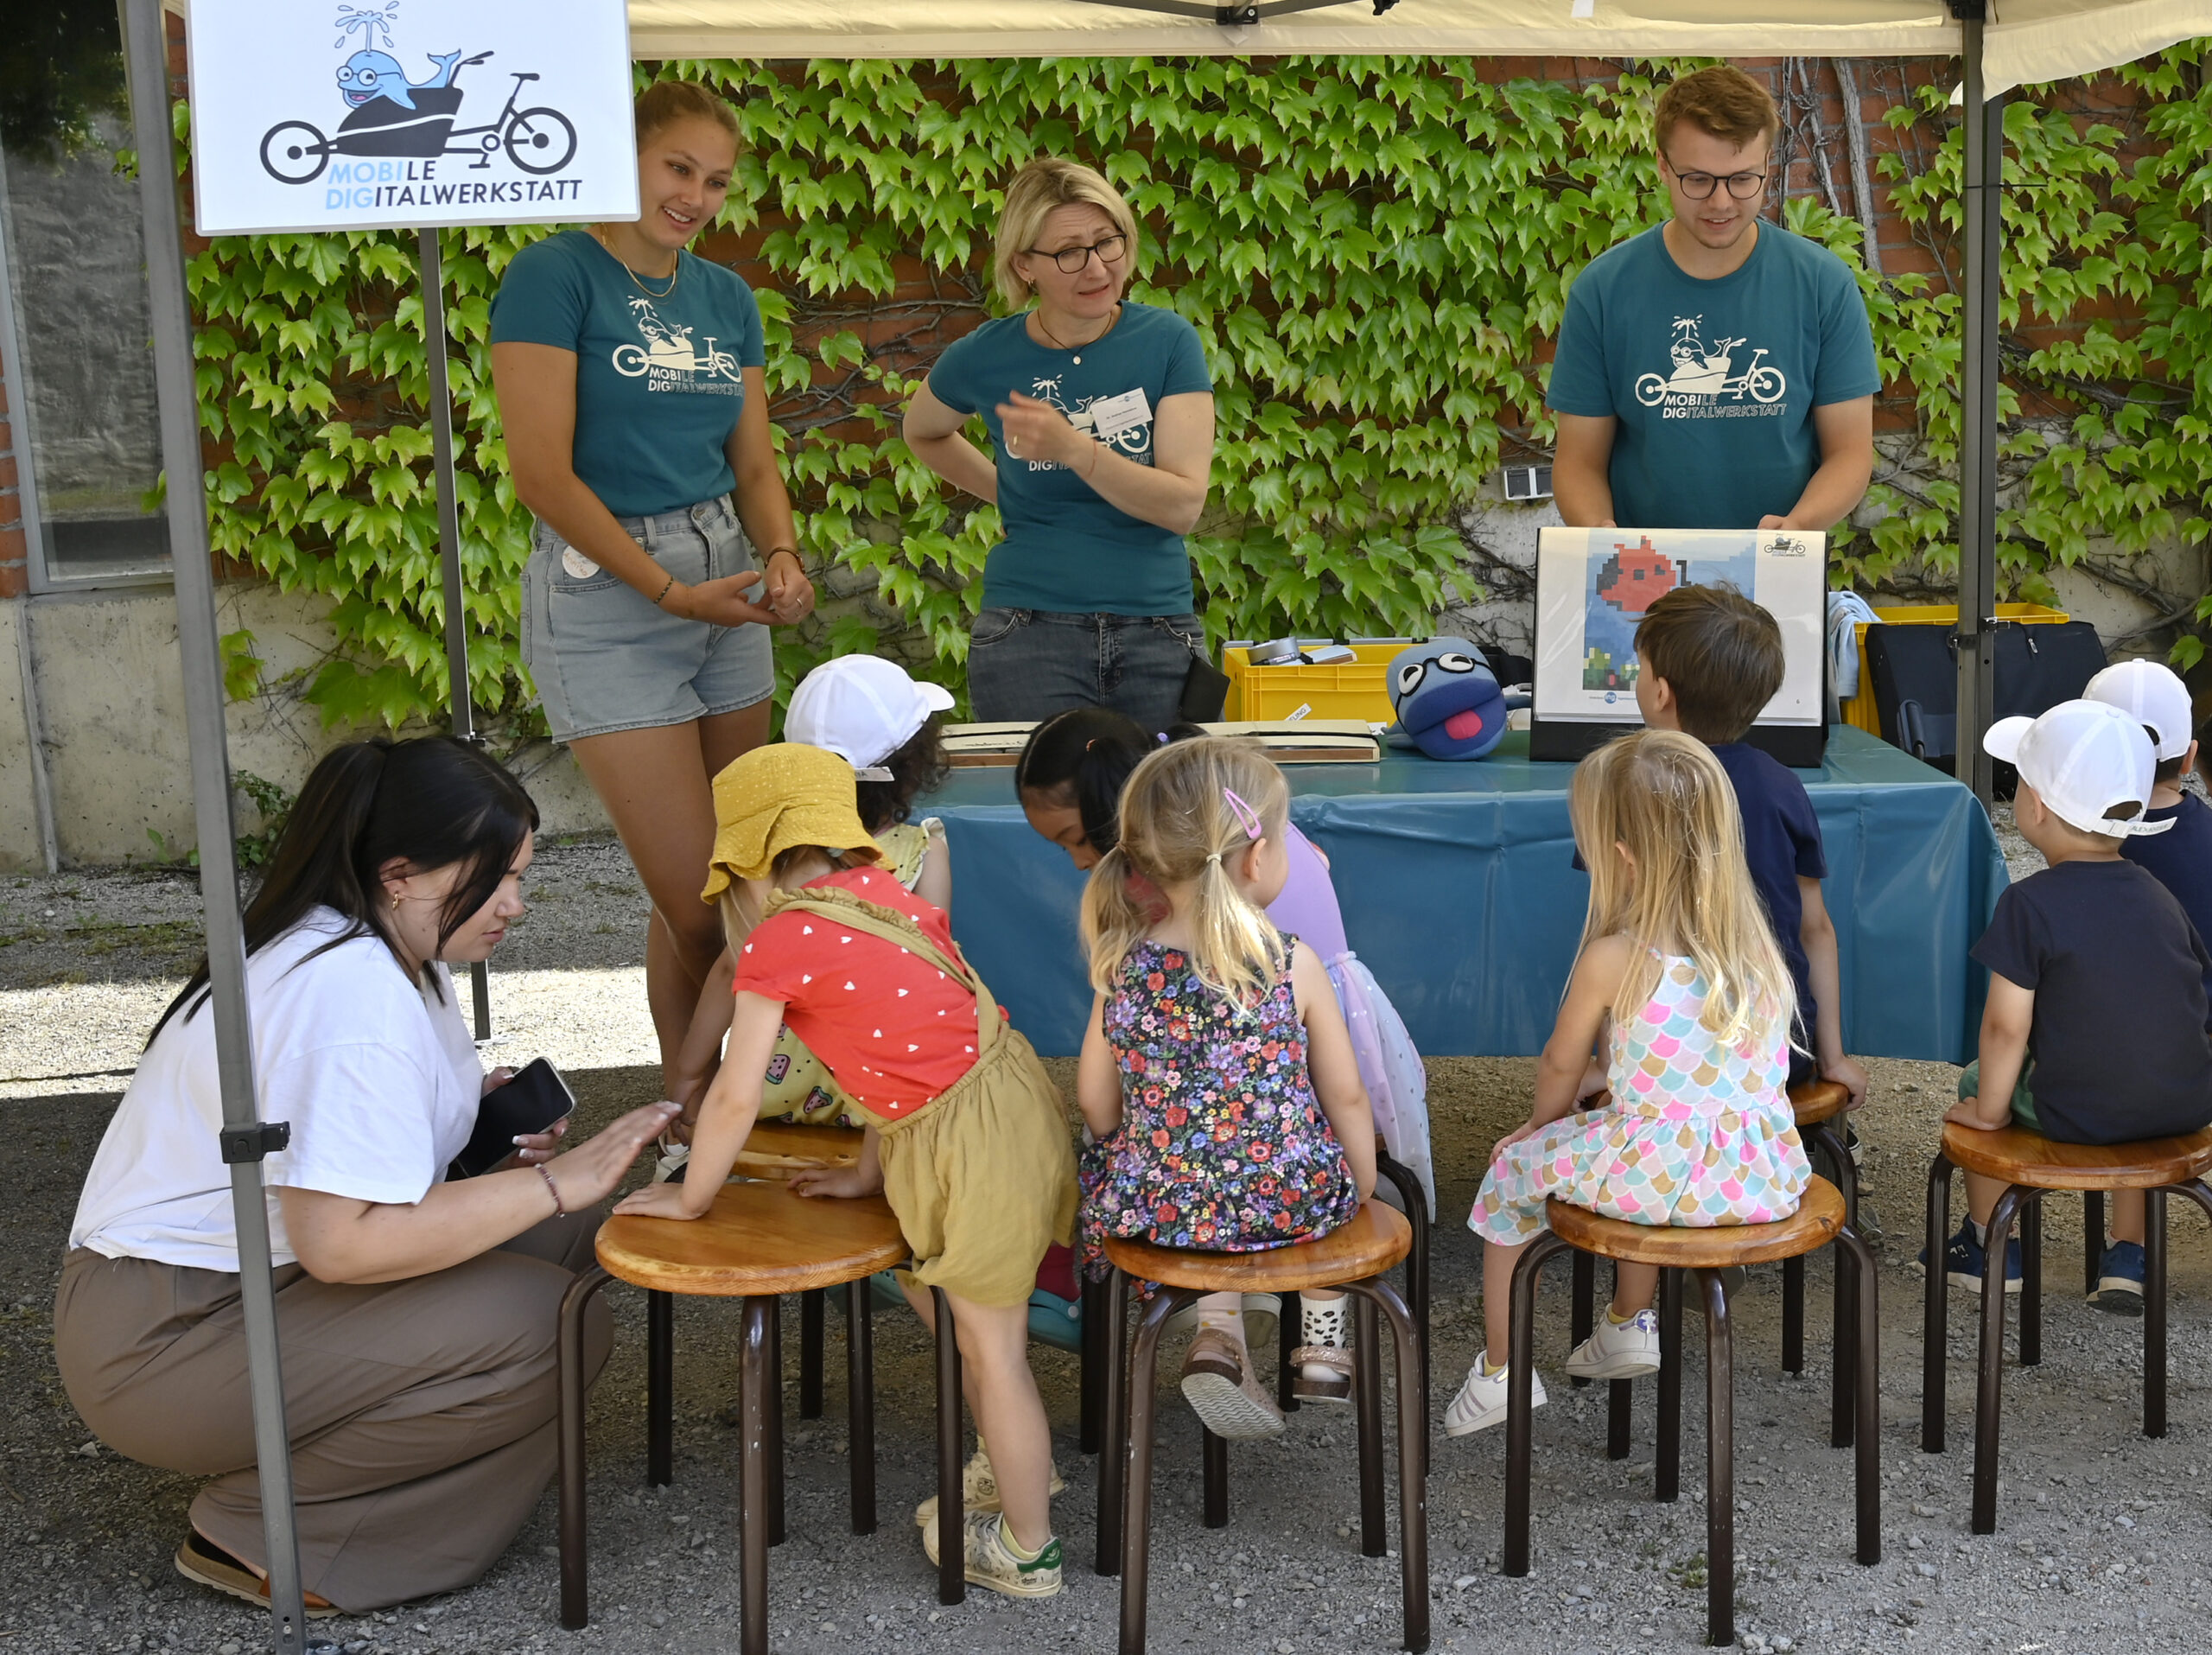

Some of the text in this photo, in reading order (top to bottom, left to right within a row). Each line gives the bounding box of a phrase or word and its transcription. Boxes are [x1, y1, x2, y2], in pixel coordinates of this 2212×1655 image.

[327, 160, 436, 184] MOBILE
[325, 179, 582, 210] DIGITALWERKSTATT
[649, 366, 695, 383] MOBILE
[647, 379, 744, 398] DIGITALWERKSTA
[1663, 393, 1718, 407] MOBILE
[1662, 403, 1787, 419] DIGITALWERKSTATT
